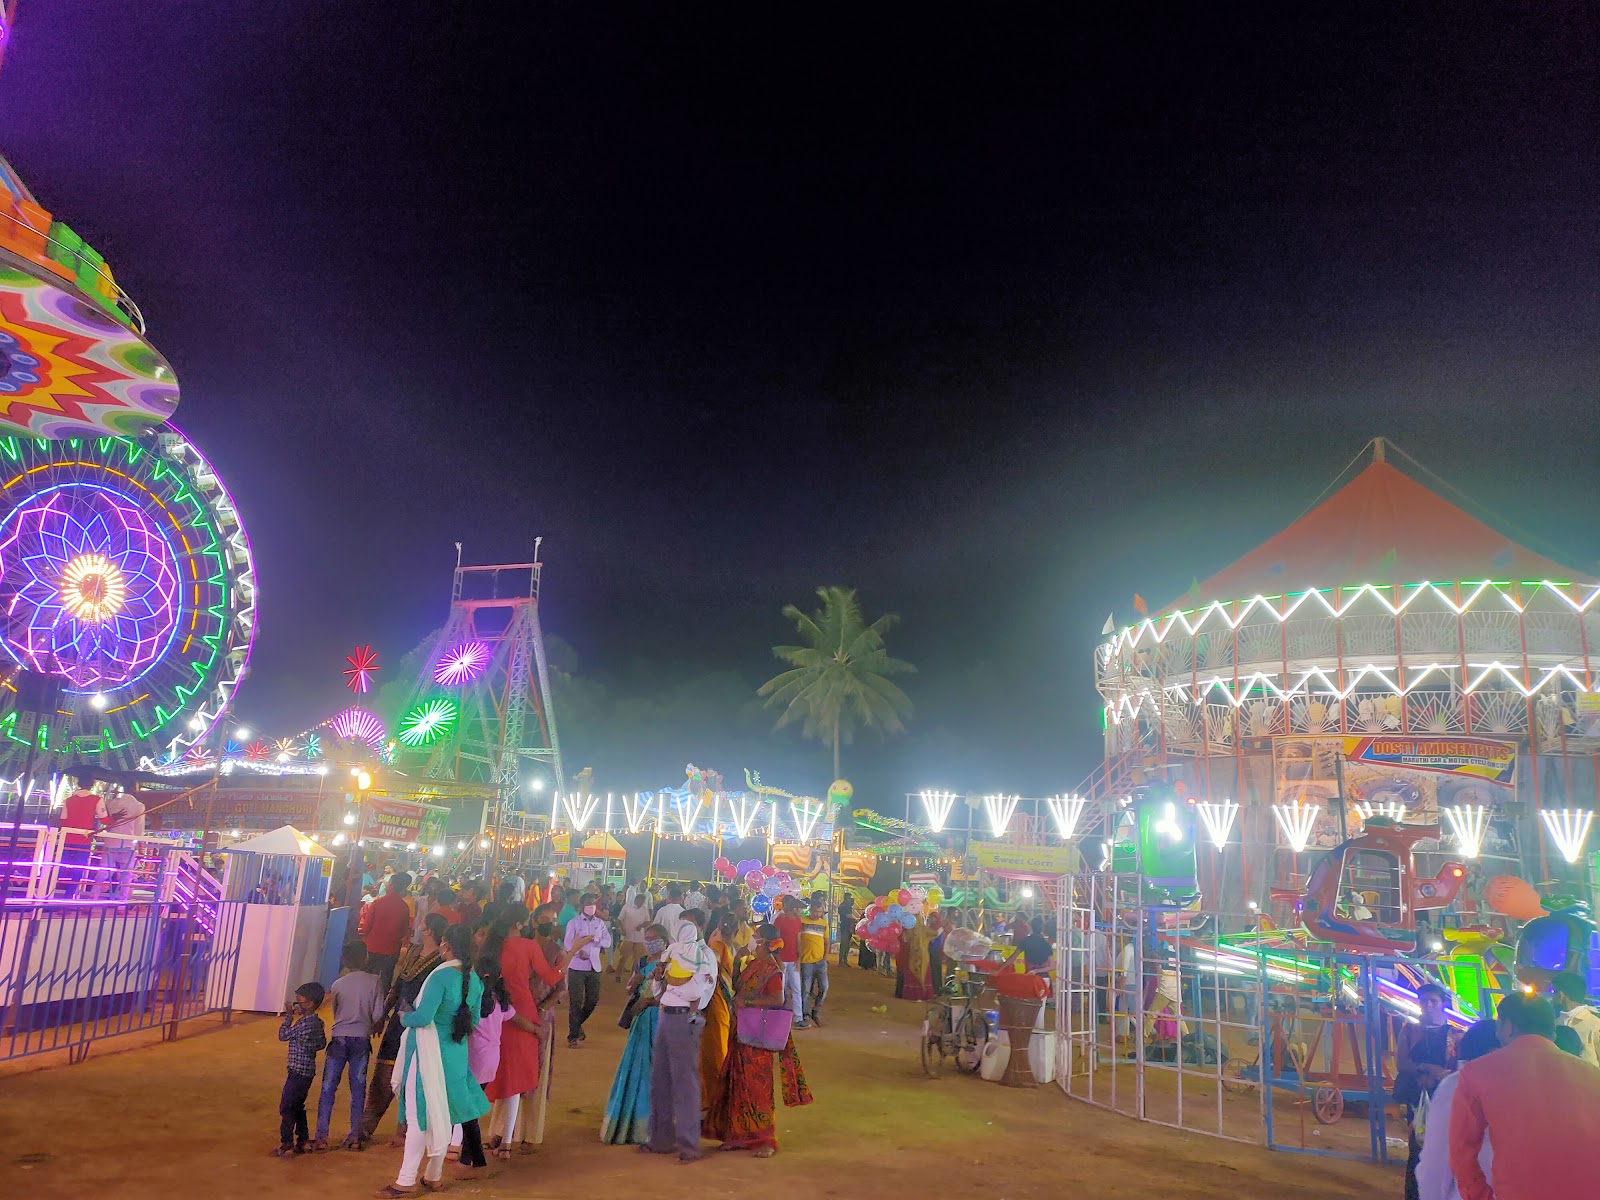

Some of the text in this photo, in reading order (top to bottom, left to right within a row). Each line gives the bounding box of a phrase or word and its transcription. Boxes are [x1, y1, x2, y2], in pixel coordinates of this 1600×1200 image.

[1373, 742, 1509, 760] DOSTI AMUSEMENTS
[377, 813, 420, 828] SUGAR CANE
[380, 825, 408, 839] JUICE
[993, 855, 1053, 867] Sweet Corn
